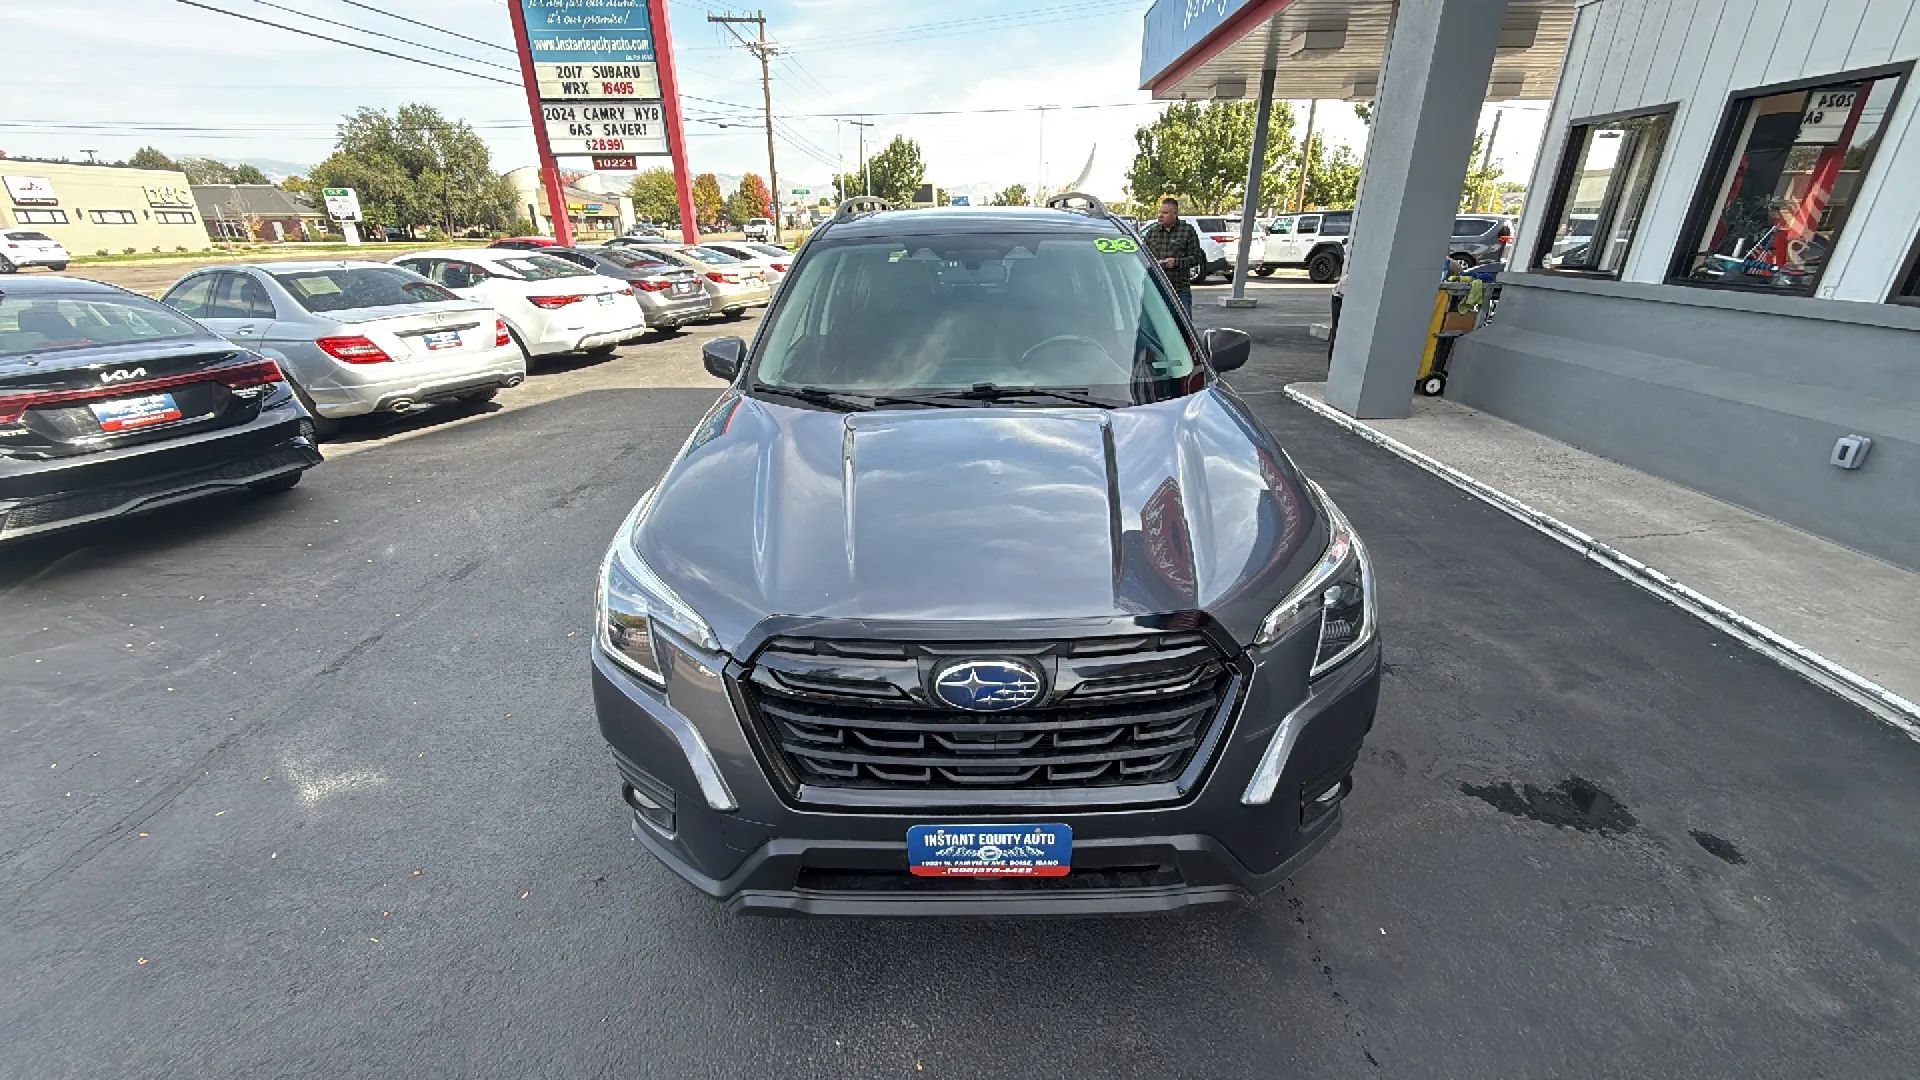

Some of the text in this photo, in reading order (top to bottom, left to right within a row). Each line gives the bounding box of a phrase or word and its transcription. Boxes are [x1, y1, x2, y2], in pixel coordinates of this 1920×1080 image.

[555, 66, 641, 79] 2017 SUBARU
[562, 82, 634, 95] WRX 16495
[545, 107, 659, 121] 2024 CAMRY HYB
[569, 124, 647, 136] GAS SAVER!
[586, 139, 625, 151] $28991
[596, 159, 634, 167] 10221
[924, 833, 1056, 846] INSTANT EQUITY AUTO
